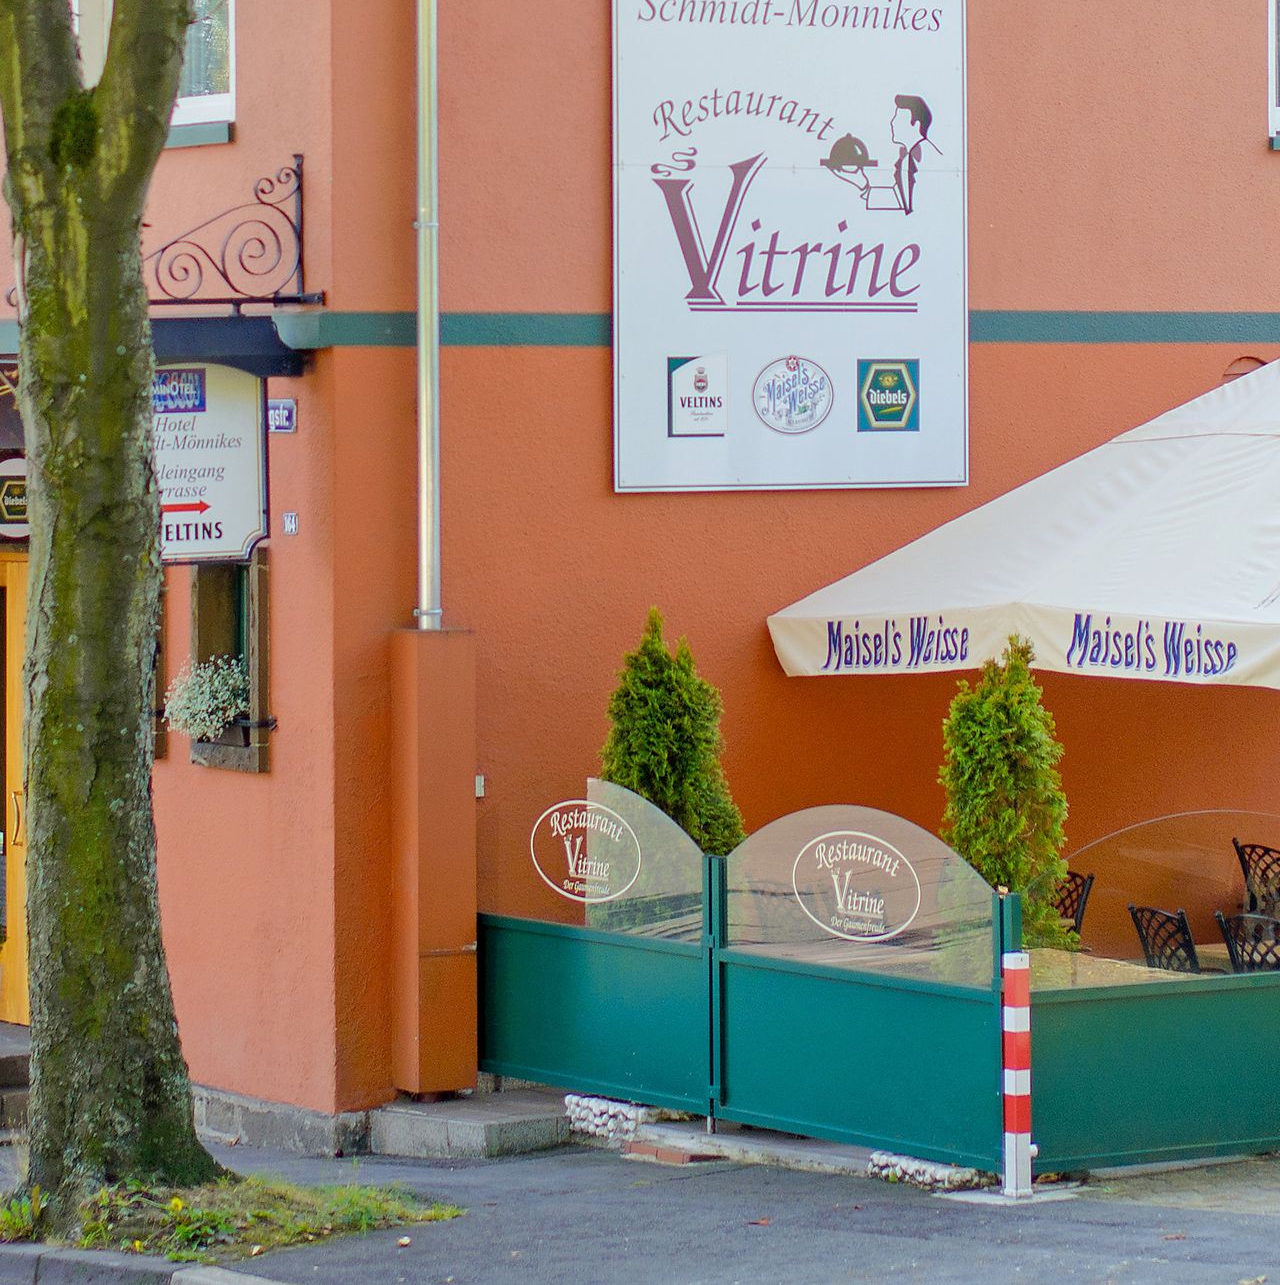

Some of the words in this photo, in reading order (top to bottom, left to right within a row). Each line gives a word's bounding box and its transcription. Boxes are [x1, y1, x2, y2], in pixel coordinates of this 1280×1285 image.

[652, 87, 835, 142] Restaurant
[651, 151, 922, 306] Vitrine
[680, 396, 723, 408] VELTINS
[762, 363, 810, 415] Maisel's
[783, 376, 825, 415] Weisse
[155, 416, 196, 432] Hotel
[269, 403, 289, 430] gstr.
[156, 464, 225, 483] leingang
[160, 485, 207, 498] rrasse
[165, 522, 223, 541] ELTINS
[822, 620, 904, 671] Maisel's
[906, 615, 969, 667] Weisse
[1066, 613, 1158, 671] Maisel's
[1162, 621, 1239, 677] Weisse
[550, 808, 624, 843] Restaurant
[564, 835, 610, 877] Vitrine
[815, 840, 899, 877] Restaurant
[831, 869, 885, 914] Vitrine
